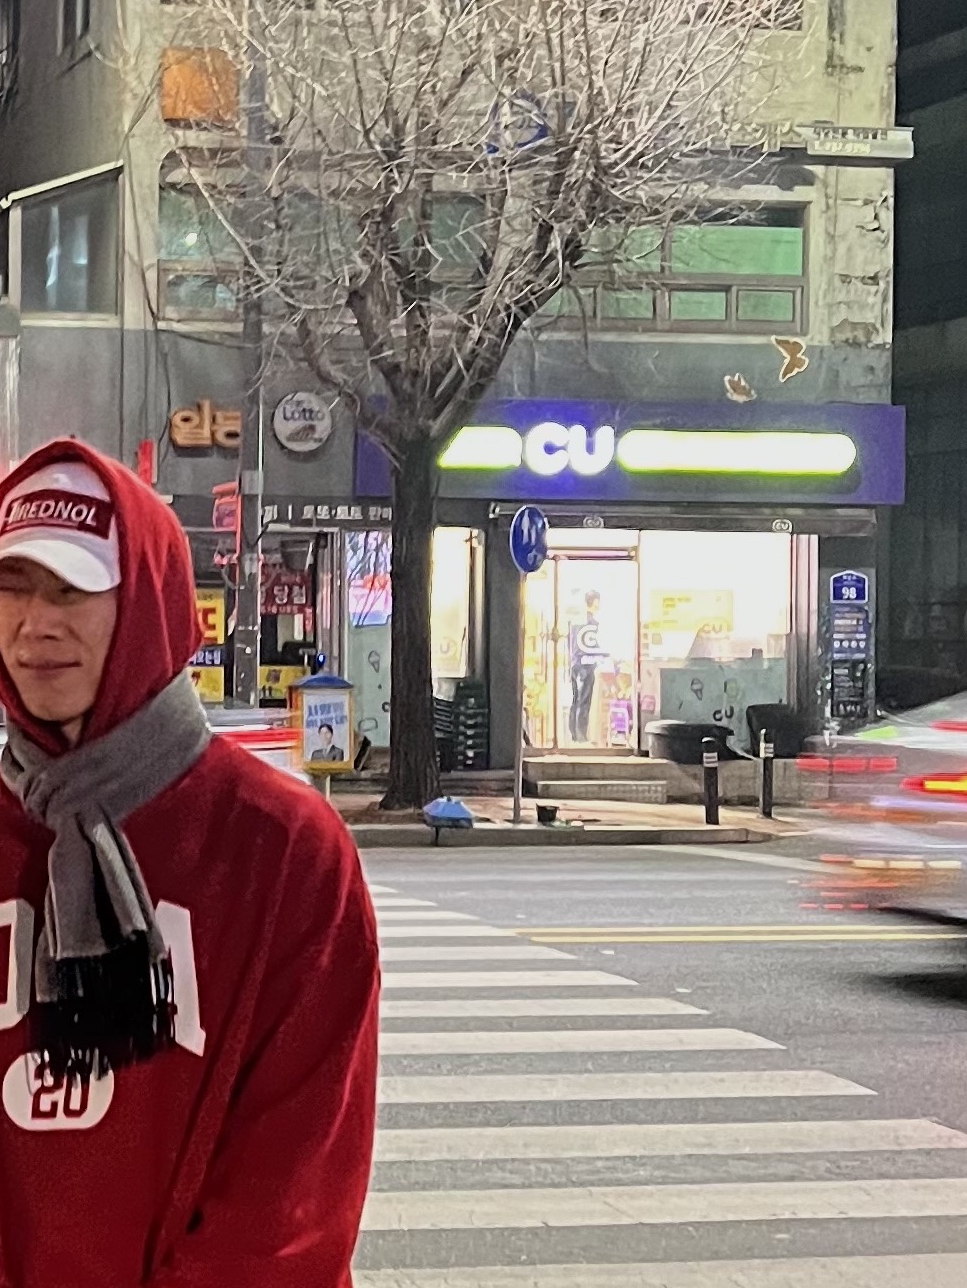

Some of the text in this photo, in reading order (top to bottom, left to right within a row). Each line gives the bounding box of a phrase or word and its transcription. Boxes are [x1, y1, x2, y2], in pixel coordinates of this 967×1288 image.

[283, 406, 326, 422] Lotto
[526, 422, 615, 475] CU
[841, 586, 857, 600] 98
[712, 705, 735, 721] CU
